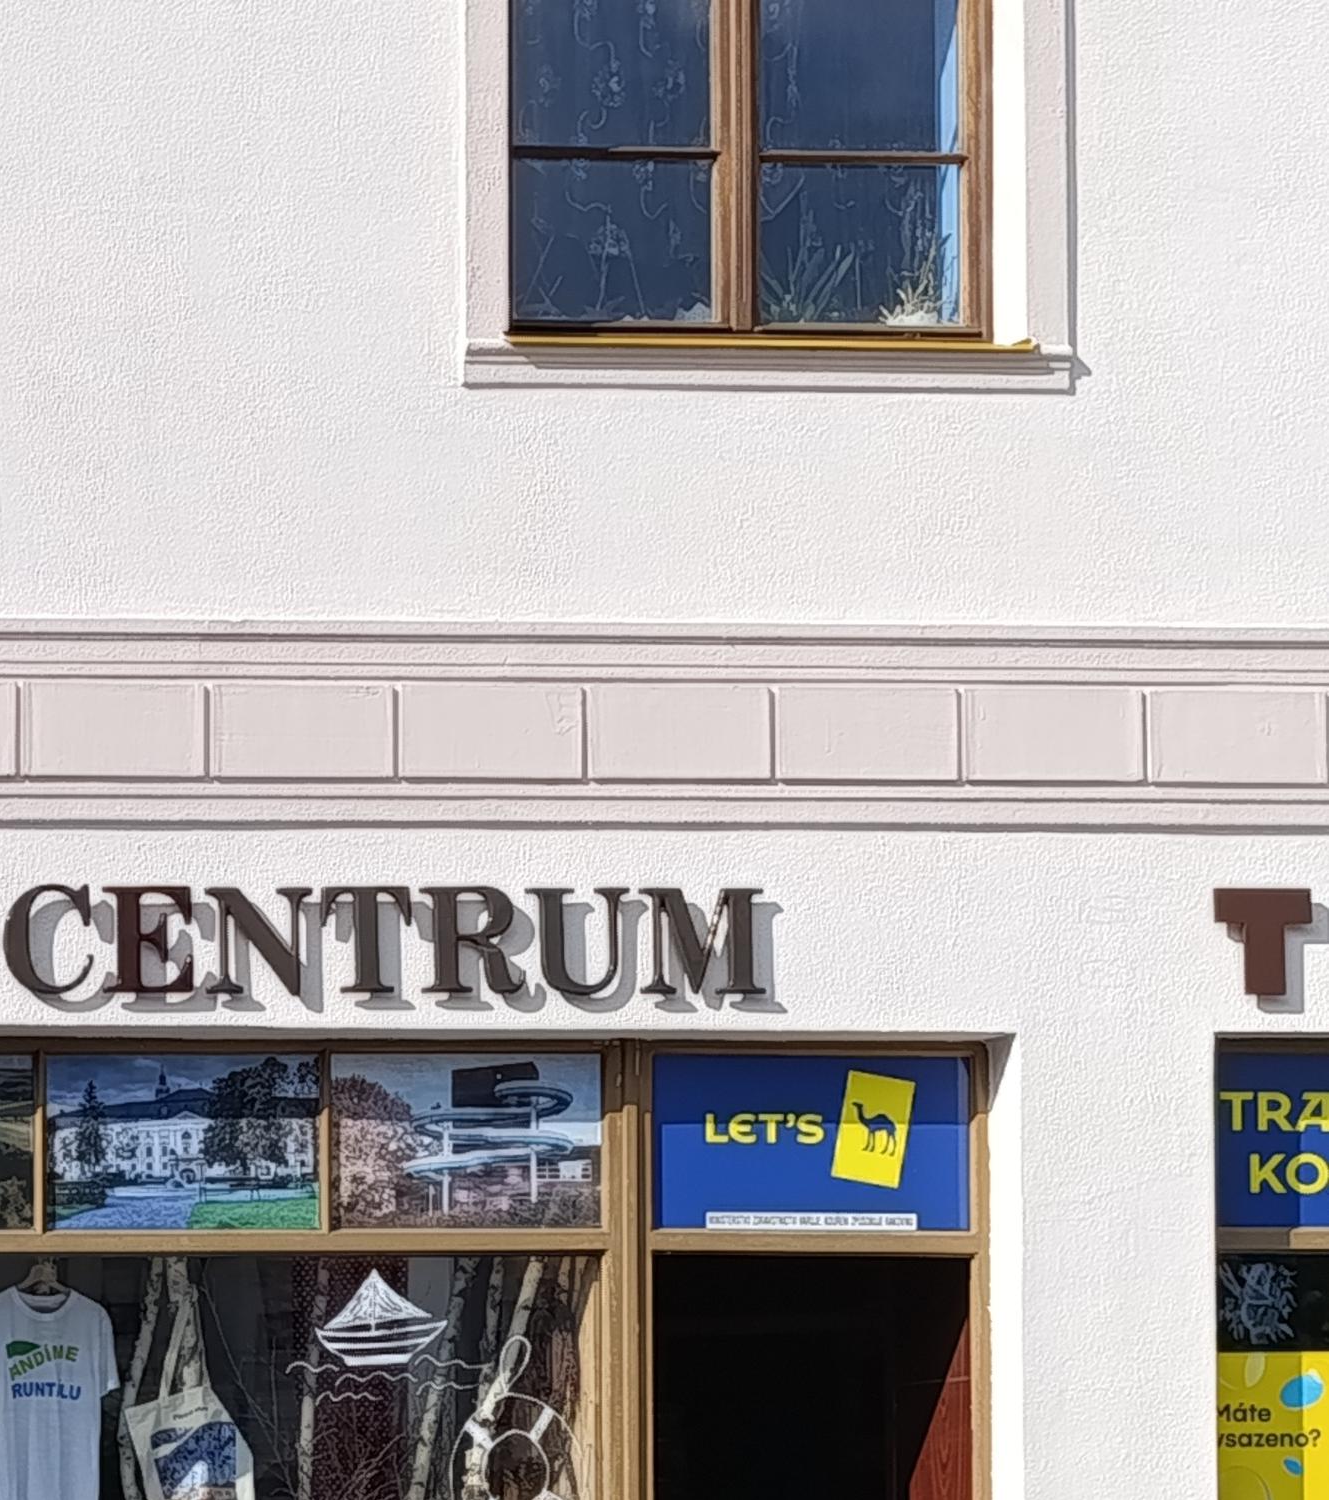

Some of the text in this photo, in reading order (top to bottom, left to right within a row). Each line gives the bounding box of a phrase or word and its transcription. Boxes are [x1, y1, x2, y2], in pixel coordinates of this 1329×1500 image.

[3, 883, 766, 997] CENTRUM
[1214, 888, 1312, 995] T
[704, 1113, 825, 1144] LET'S
[1219, 1091, 1329, 1132] TRA
[1249, 1152, 1329, 1196] KO
